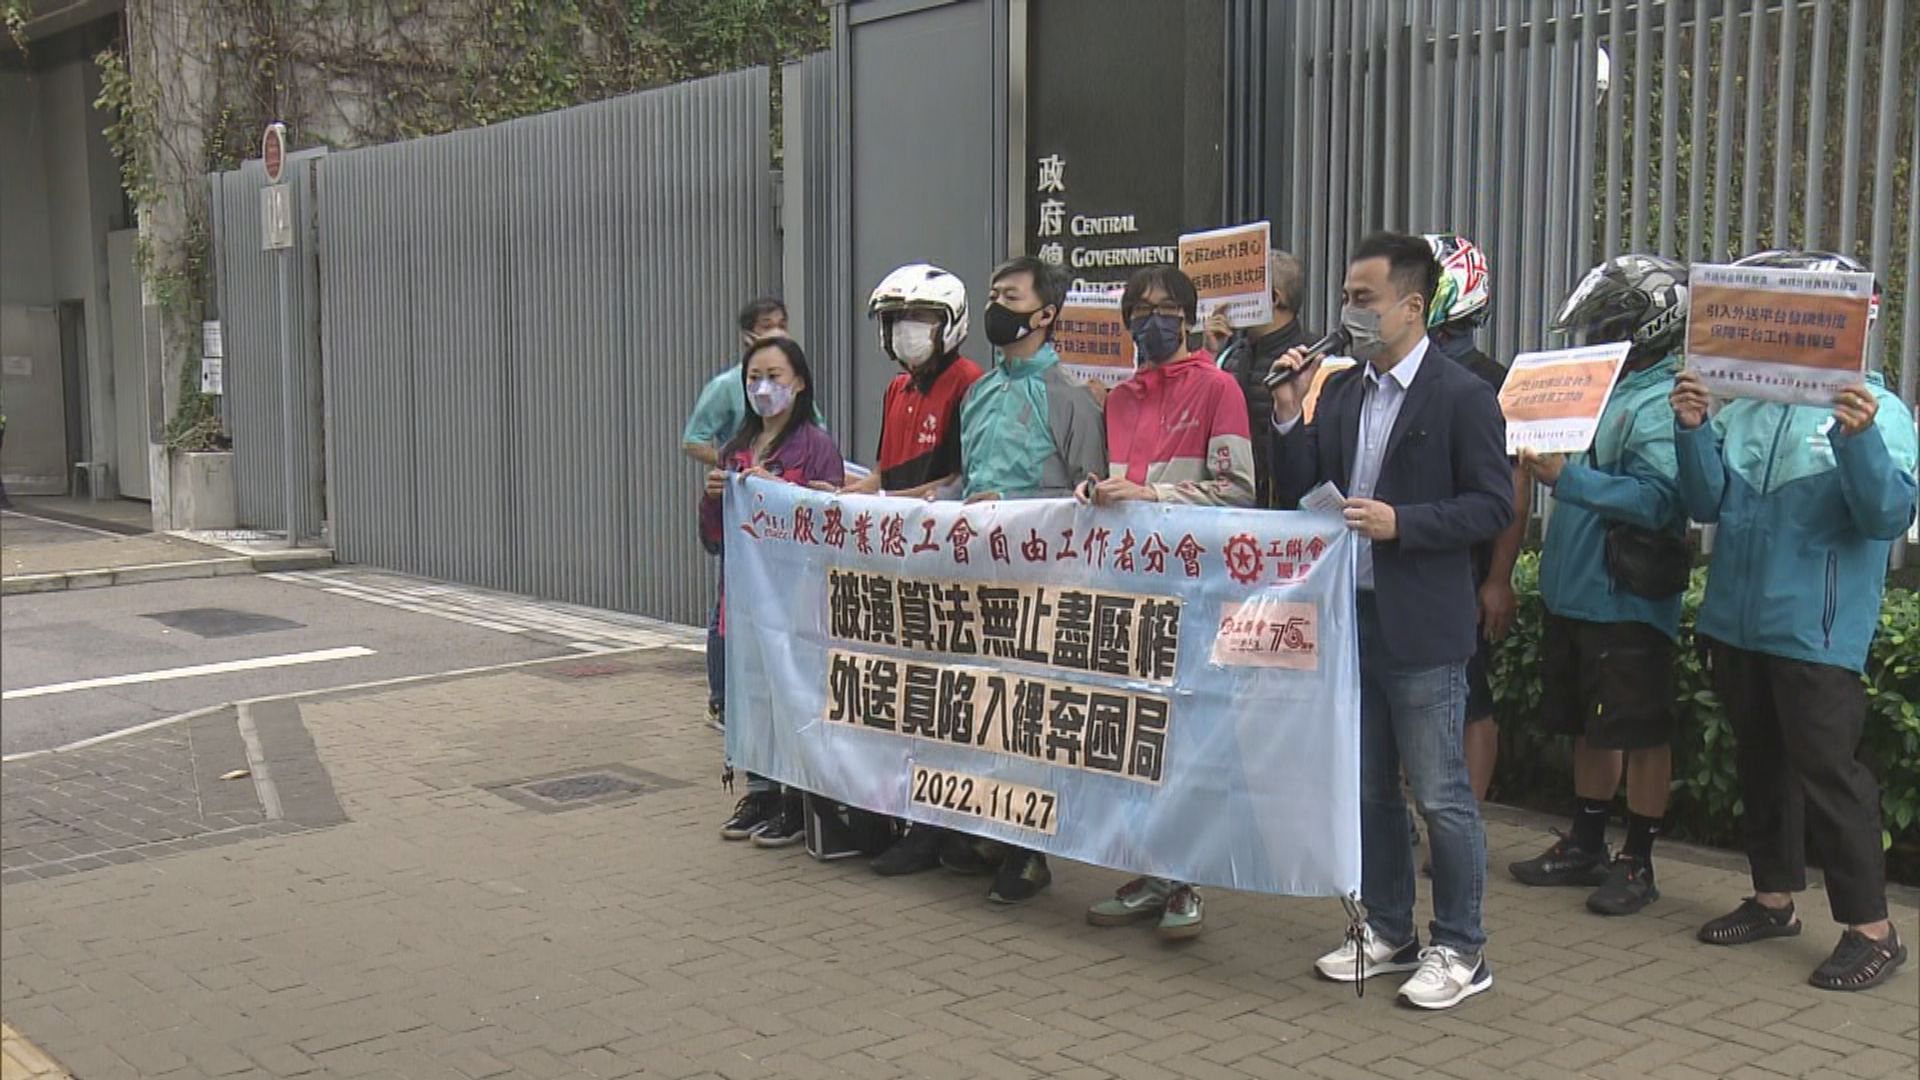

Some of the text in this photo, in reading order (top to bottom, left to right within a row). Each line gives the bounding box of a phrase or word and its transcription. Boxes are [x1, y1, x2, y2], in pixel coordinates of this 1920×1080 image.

[1071, 215, 1138, 236] CENTRAL
[1071, 246, 1178, 267] GOVERNMENT
[793, 506, 1206, 579] 服務業總工會自由工作者分會
[829, 570, 1181, 681] 被演算法無止盡壓榨
[828, 653, 1169, 782] 外送員陷入裸奔困局
[914, 768, 1056, 831] 2022.11.27
